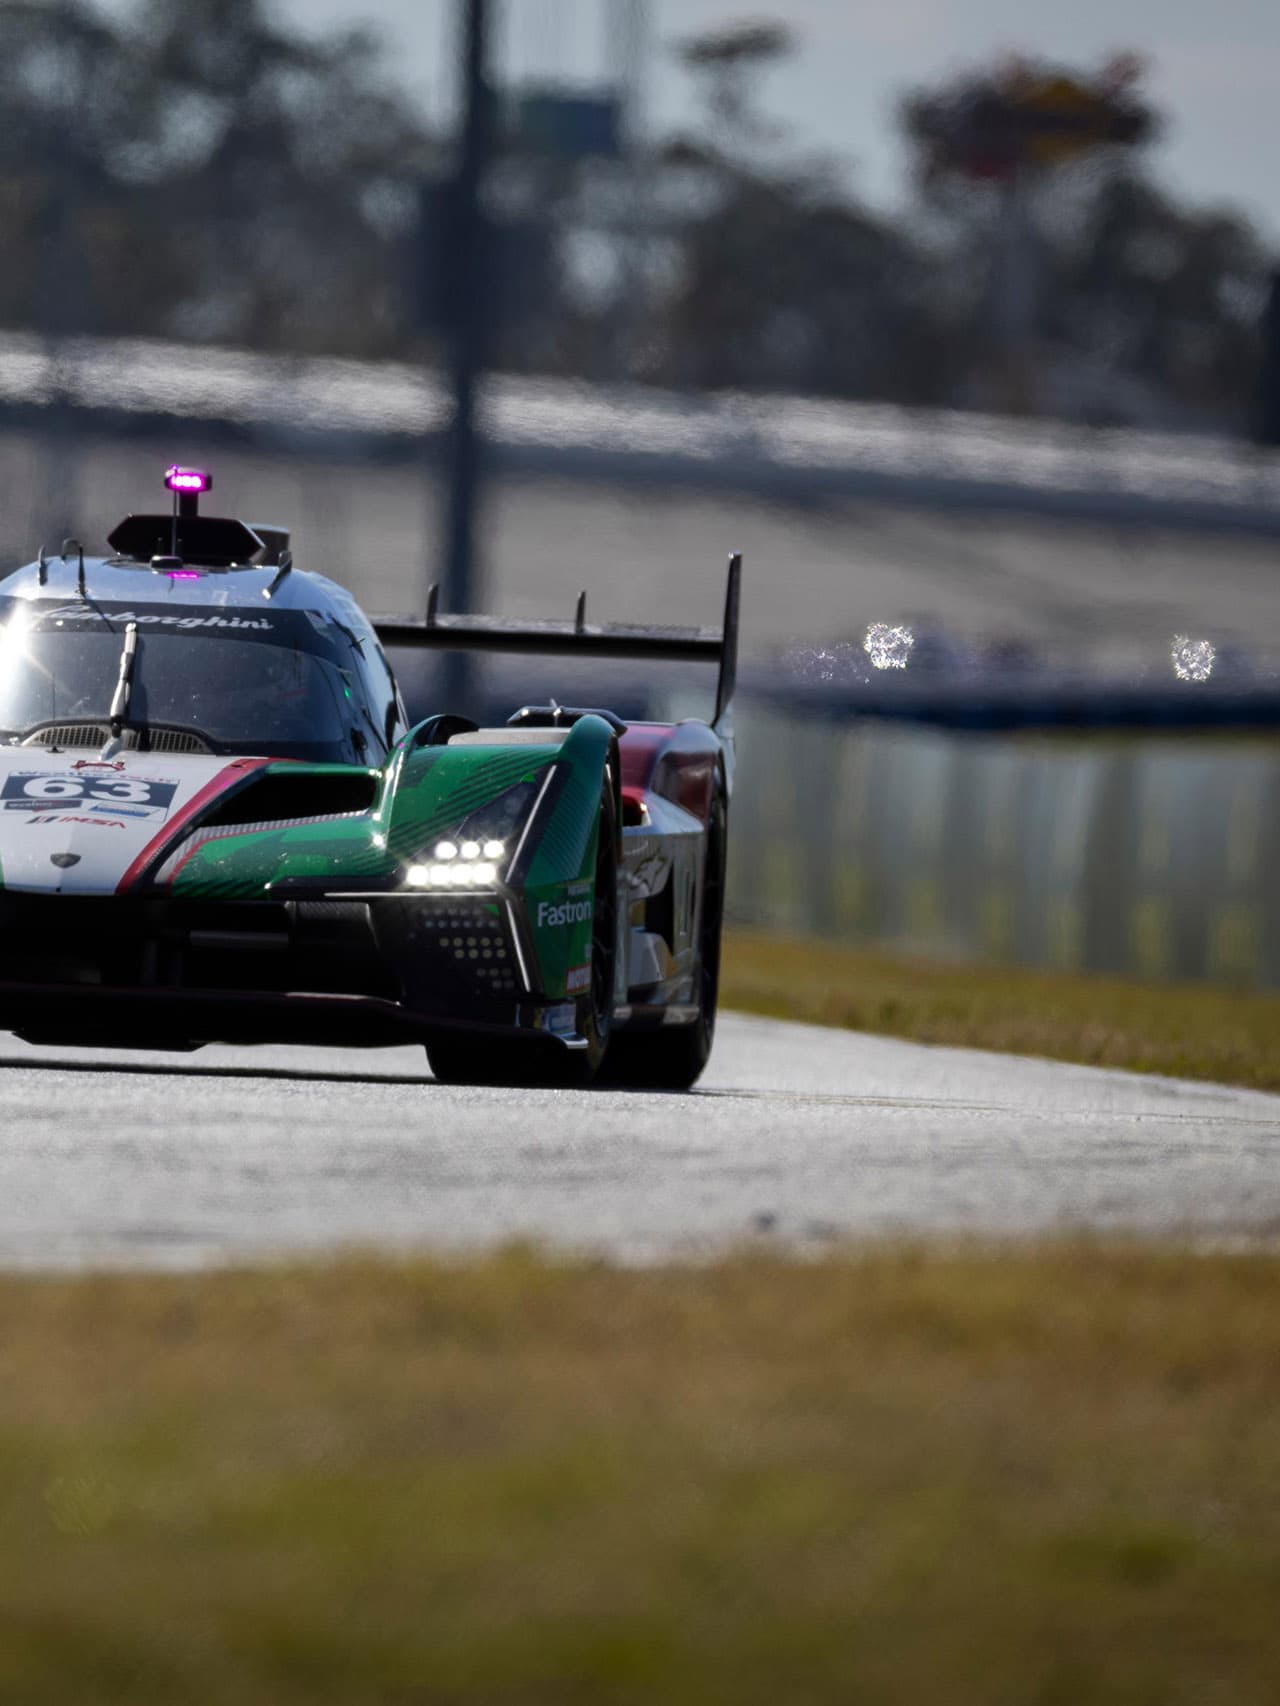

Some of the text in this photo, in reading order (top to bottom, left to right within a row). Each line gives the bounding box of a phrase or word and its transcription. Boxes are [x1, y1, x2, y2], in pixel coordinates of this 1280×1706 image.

[37, 604, 274, 630] Lamborghini
[23, 776, 152, 803] 63
[537, 901, 592, 928] Fastron
